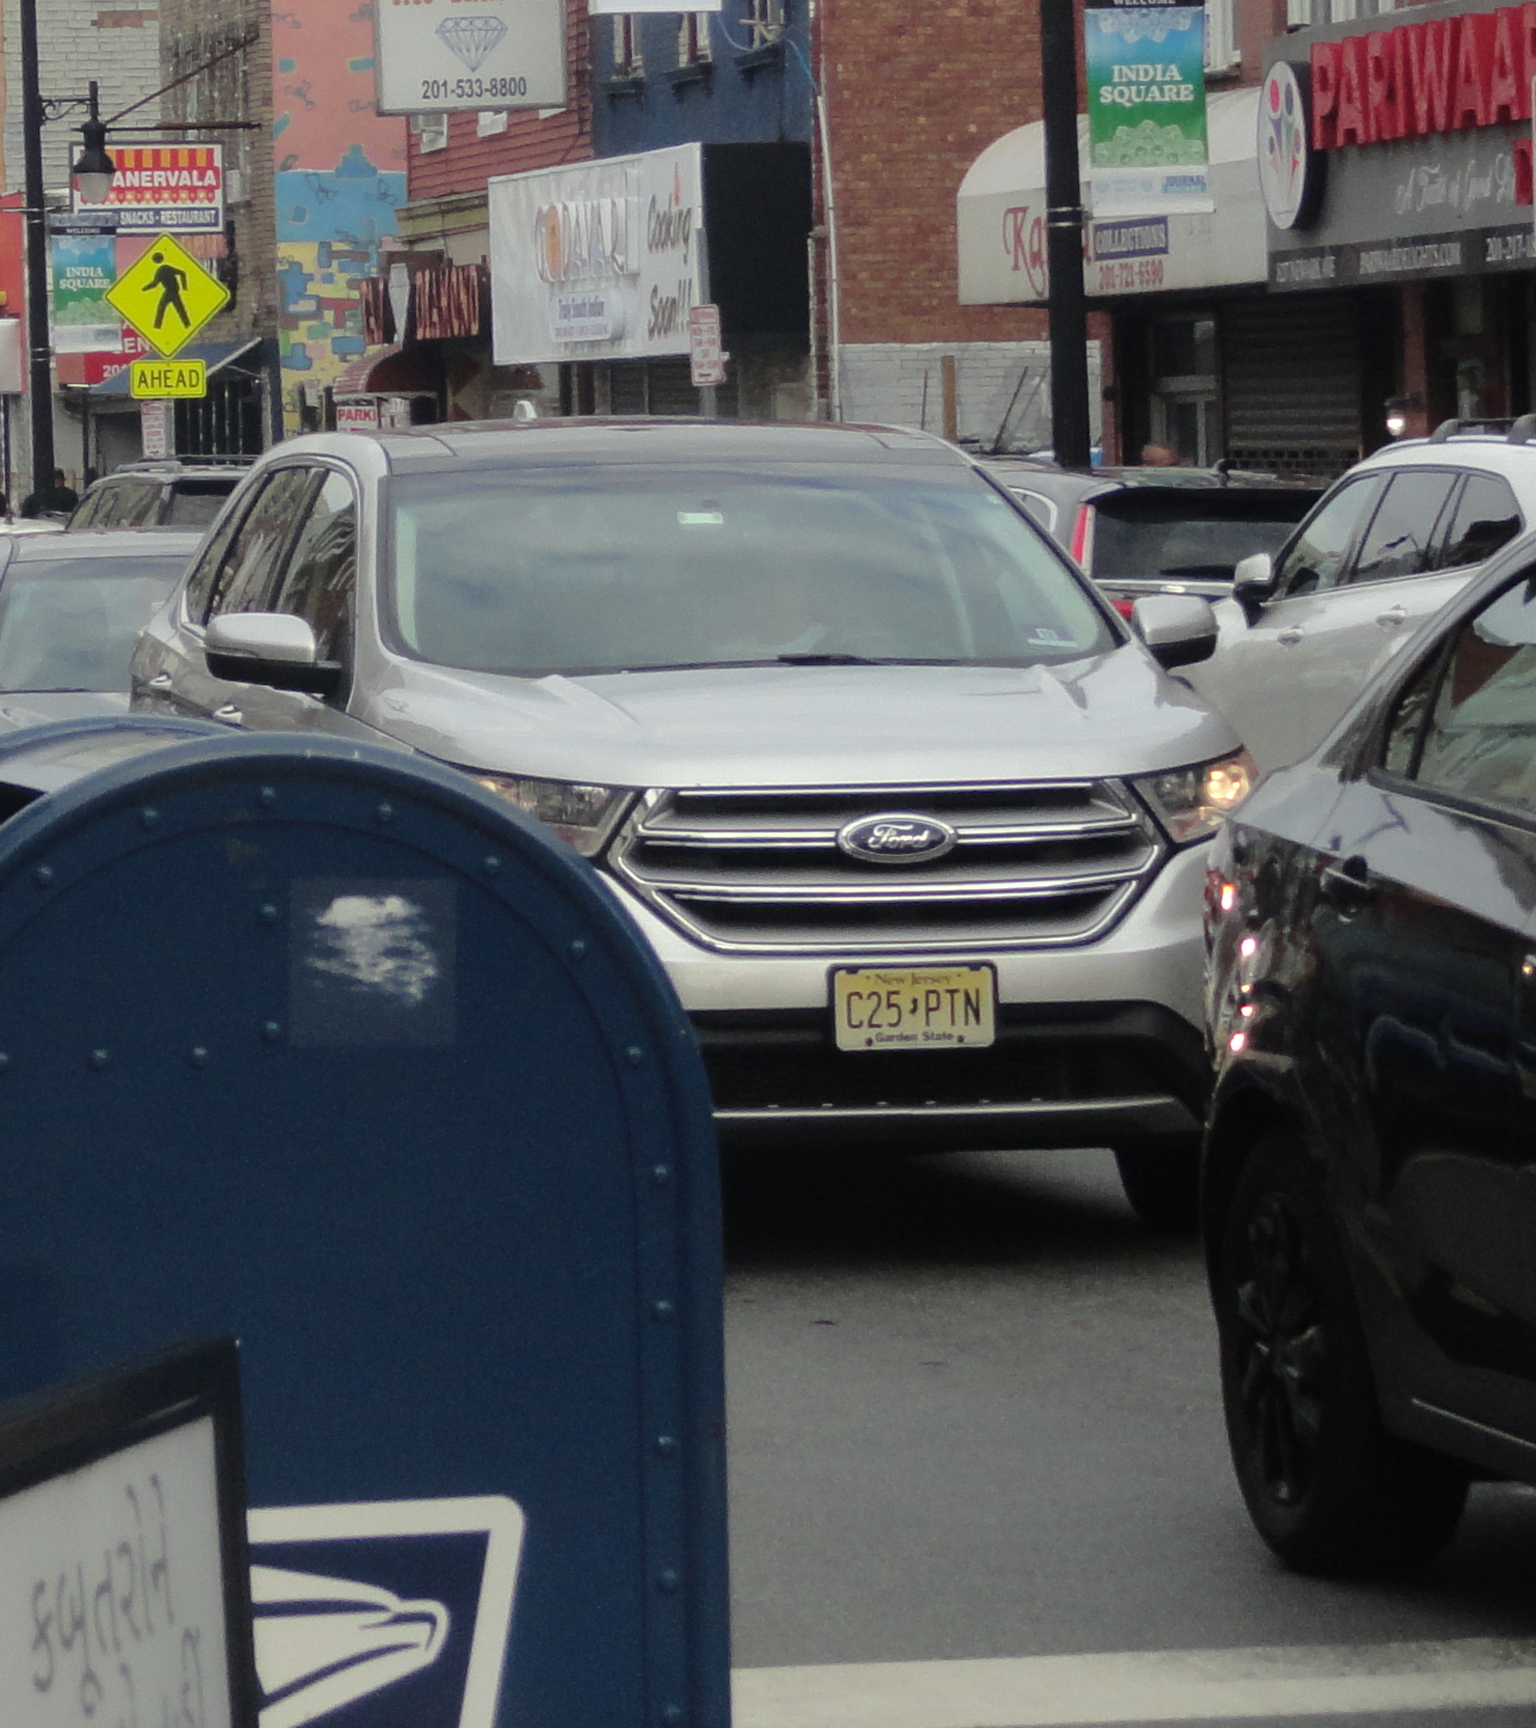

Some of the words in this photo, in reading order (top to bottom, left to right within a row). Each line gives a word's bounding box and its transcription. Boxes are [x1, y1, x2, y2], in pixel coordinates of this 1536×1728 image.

[1112, 64, 1182, 82] INDIA
[421, 76, 527, 100] 201-533-8800
[1099, 84, 1194, 107] SQUARE
[112, 170, 217, 188] ANERVALA
[120, 211, 154, 225] SNACKS
[161, 210, 216, 224] RESTAURANT
[648, 193, 692, 266] Cooking
[66, 267, 103, 278] INDIA
[59, 279, 110, 292] SQUARE
[137, 369, 200, 389] AHEAD
[868, 824, 929, 849] Ford
[875, 973, 905, 985] New
[911, 973, 950, 986] Jersey
[847, 990, 902, 1029] C25
[925, 988, 980, 1027] PTN
[875, 1032, 918, 1042] Garden
[922, 1031, 954, 1041] State
